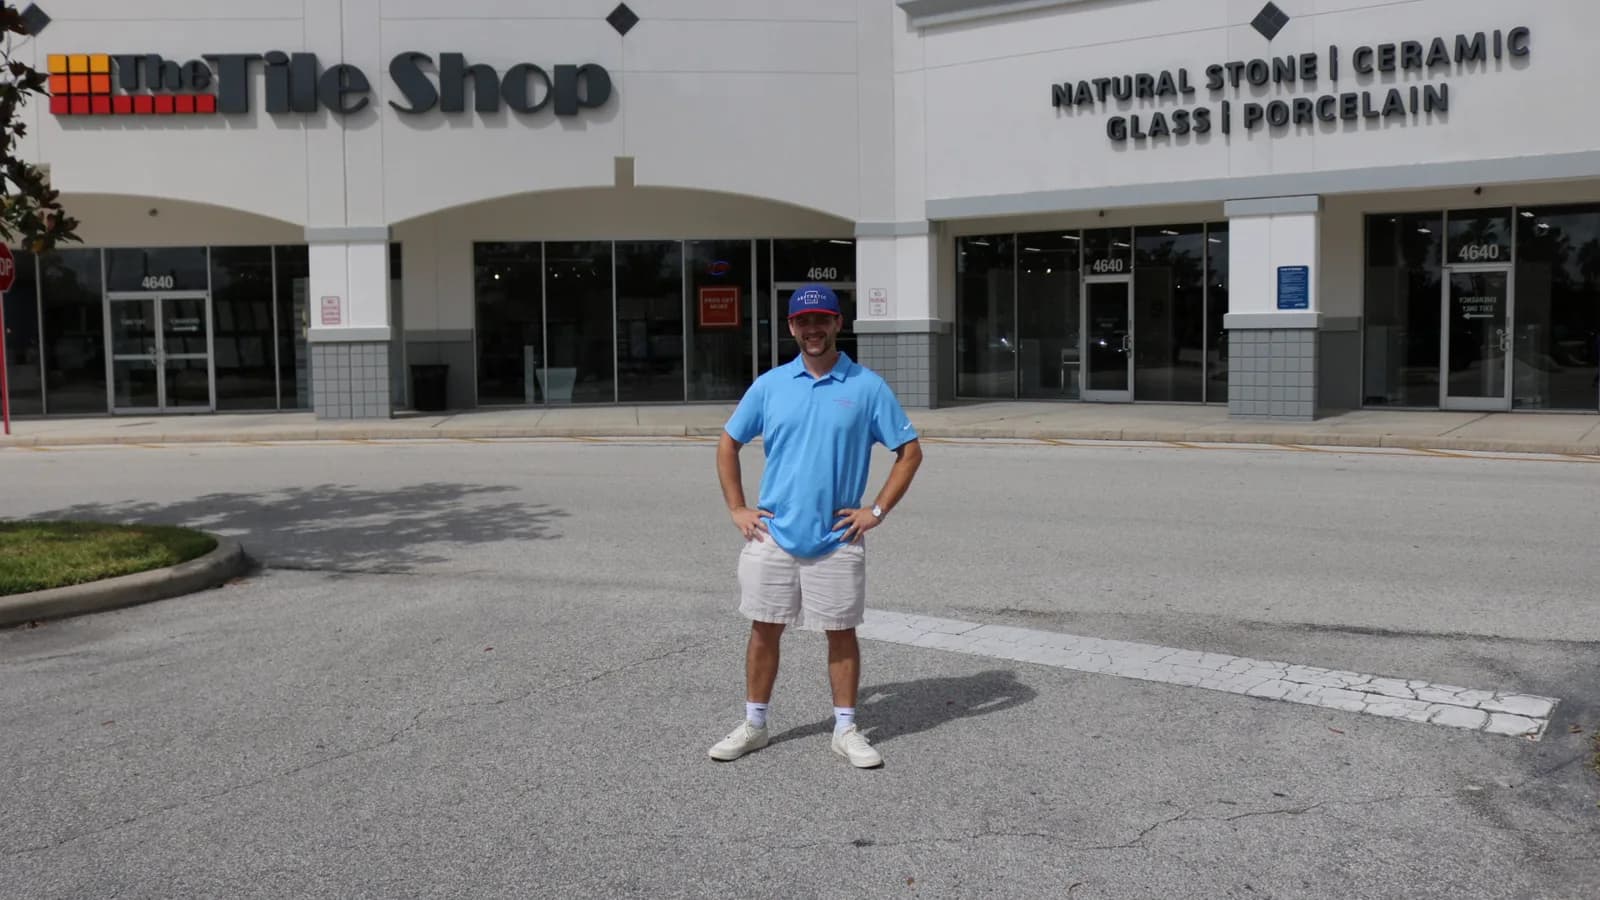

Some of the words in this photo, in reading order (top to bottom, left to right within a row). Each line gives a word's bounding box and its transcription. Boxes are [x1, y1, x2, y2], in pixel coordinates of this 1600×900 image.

[1051, 67, 1195, 107] NATURAL
[1205, 52, 1318, 91] STONE
[1352, 26, 1531, 75] CERAMIC
[110, 53, 213, 92] The
[201, 50, 371, 114] Tile
[388, 51, 612, 116] Shop
[1106, 106, 1211, 141] GLASS
[1243, 83, 1449, 130] PORCELAIN
[1459, 244, 1500, 260] 4640
[807, 266, 838, 280] 4640
[1093, 258, 1123, 273] 4640
[142, 275, 174, 289] 4640
